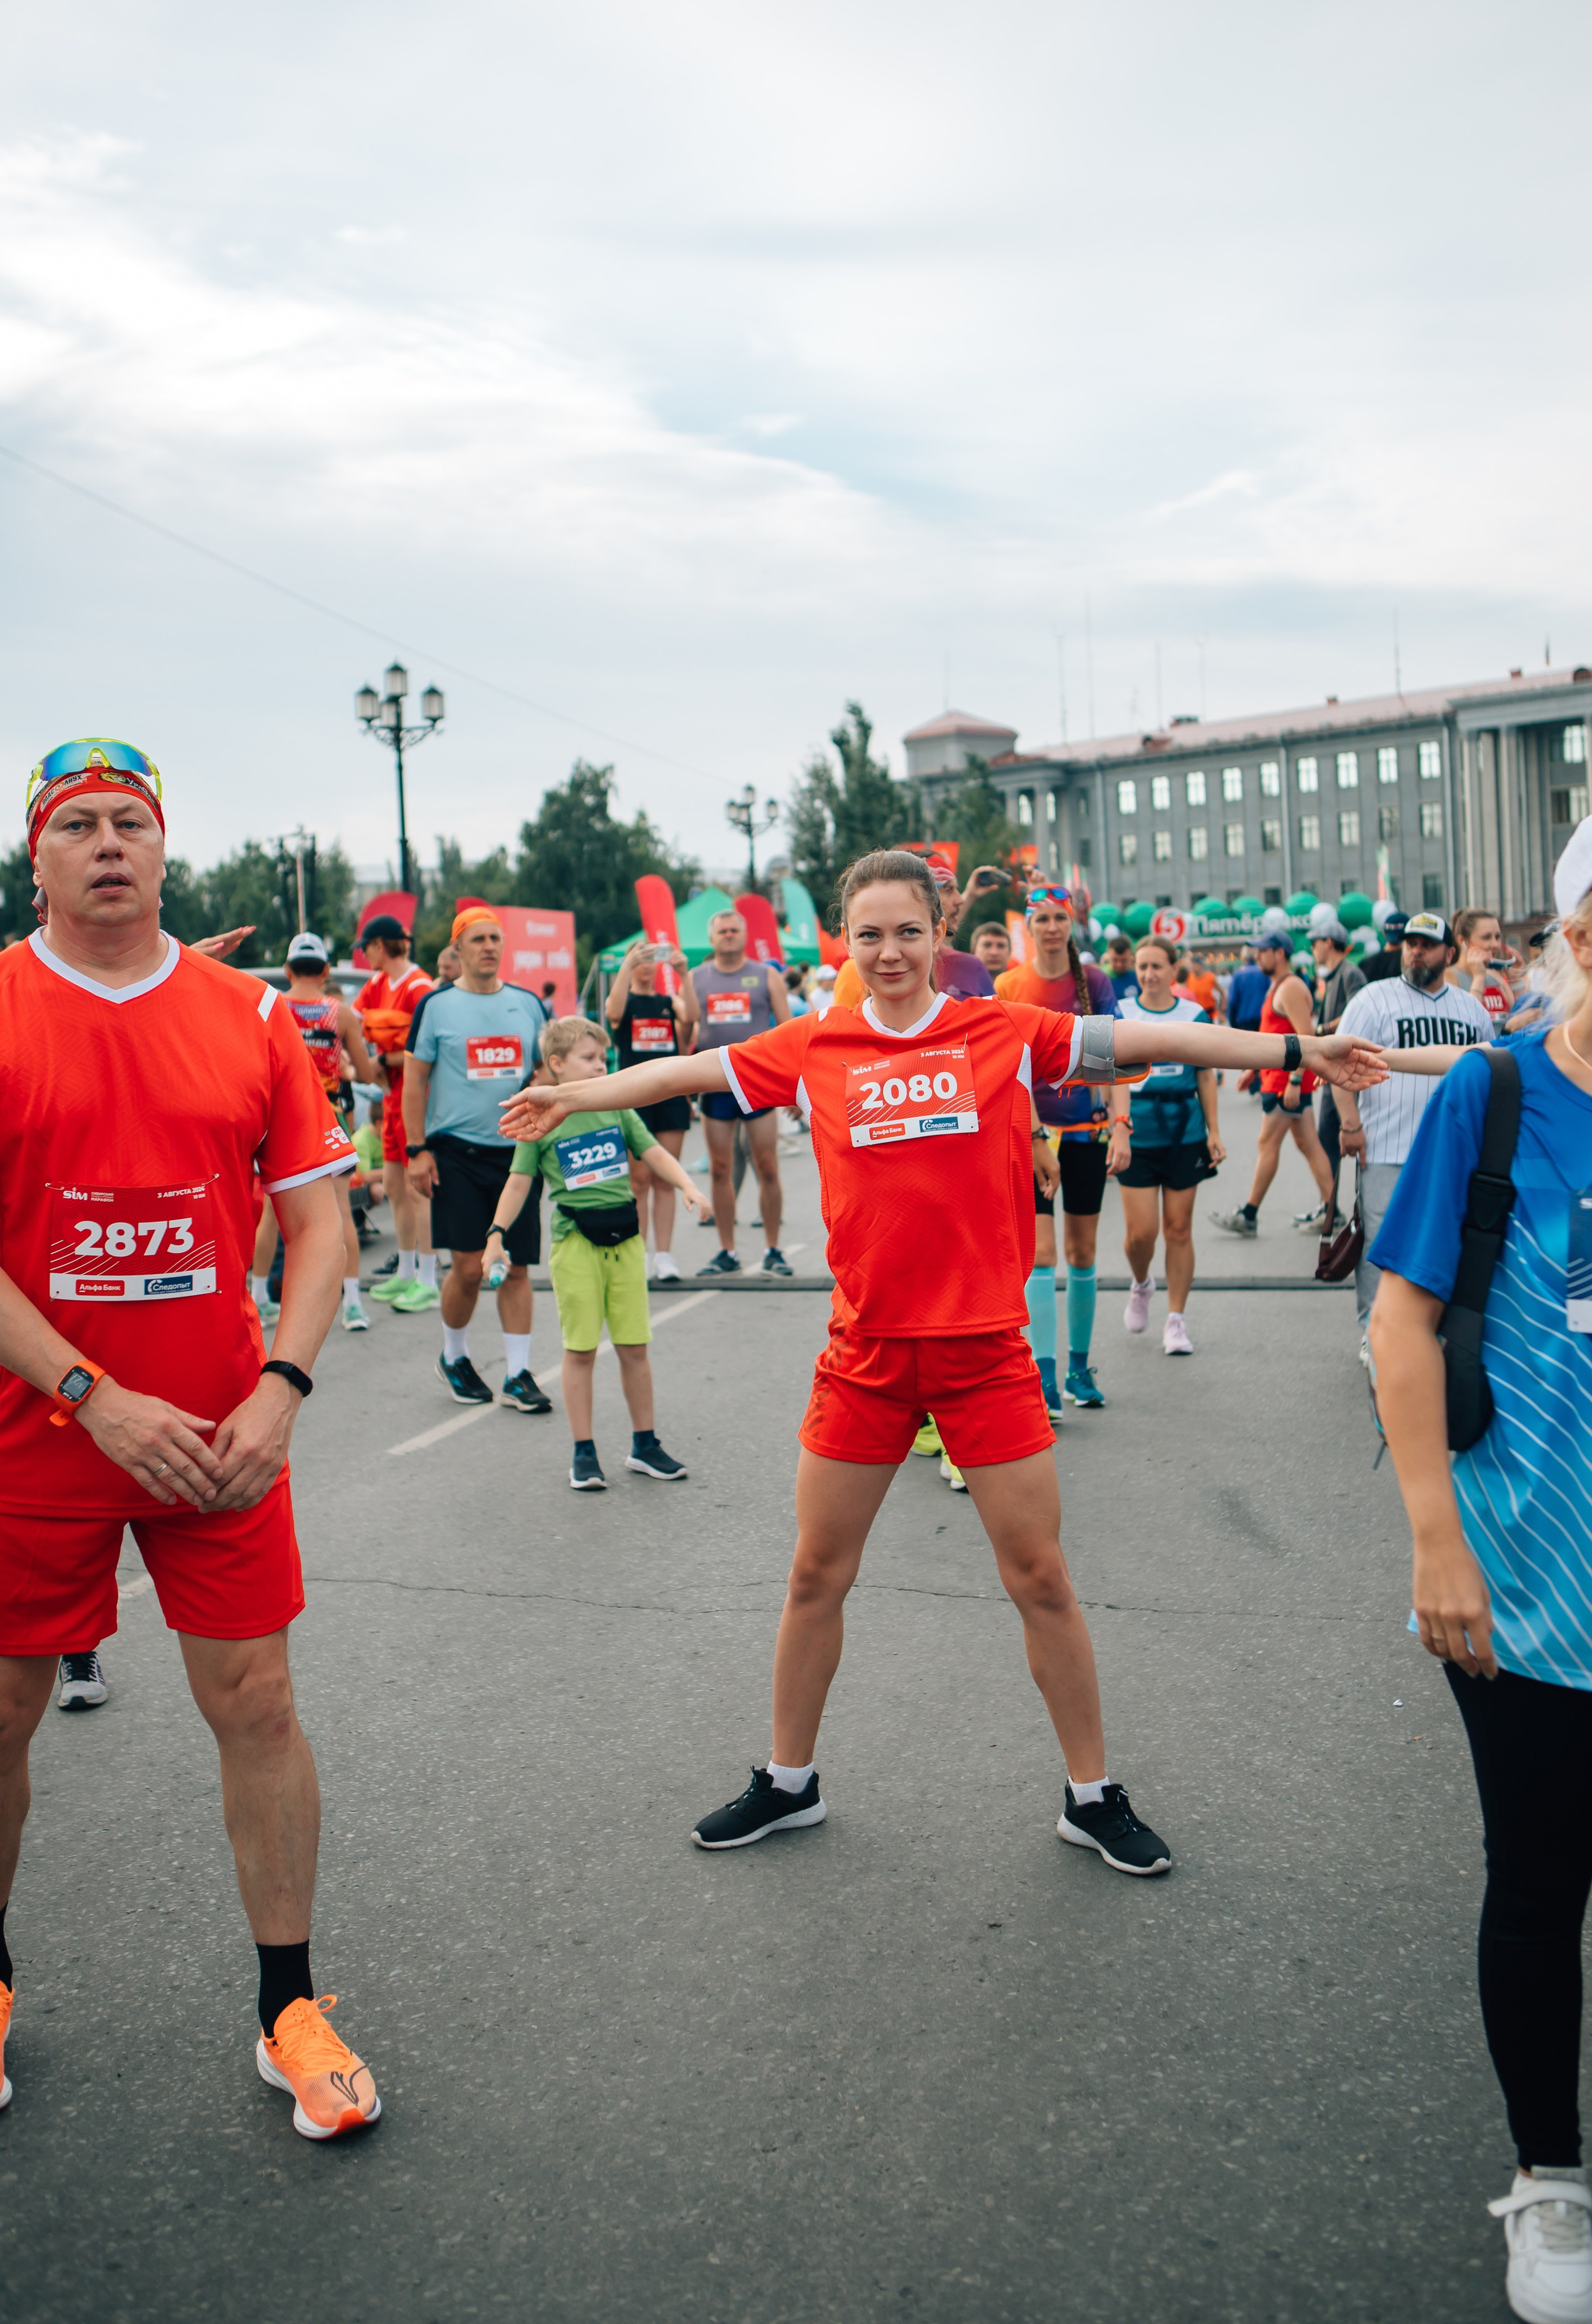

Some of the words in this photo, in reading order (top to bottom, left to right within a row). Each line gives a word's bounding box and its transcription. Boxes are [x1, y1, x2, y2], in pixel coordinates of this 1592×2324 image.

[1396, 1016, 1478, 1048] ROUGH
[475, 1046, 516, 1064] 1829
[859, 1072, 958, 1110] 2080
[872, 1129, 889, 1137] Альфа
[568, 1142, 617, 1168] 3229
[163, 1189, 192, 1197] АВГУСТА
[74, 1217, 194, 1257] 2873
[79, 1283, 102, 1292] Альфа
[152, 1281, 191, 1291] Следопыт
